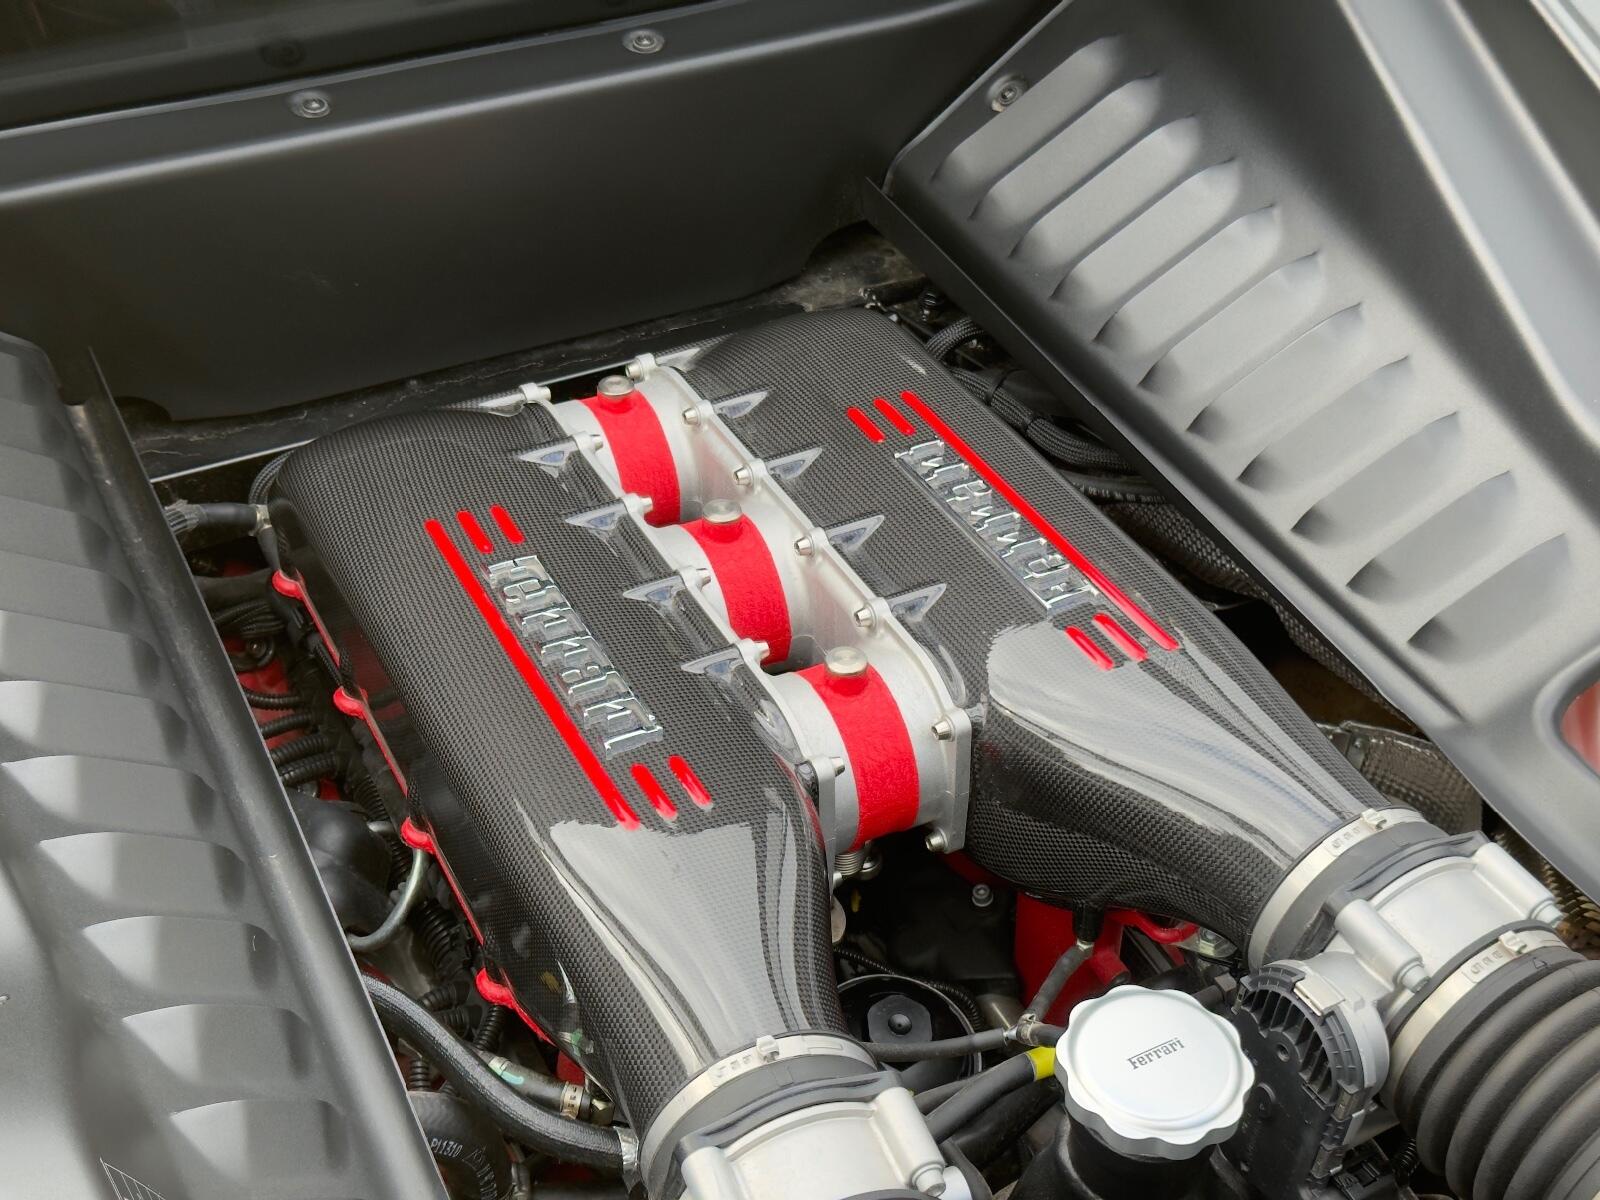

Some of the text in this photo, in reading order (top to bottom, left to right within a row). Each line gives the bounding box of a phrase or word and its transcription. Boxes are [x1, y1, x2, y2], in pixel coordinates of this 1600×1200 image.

[894, 436, 1099, 618] Ferrari
[485, 555, 664, 759] Ferrari
[1127, 1037, 1184, 1070] Ferrari
